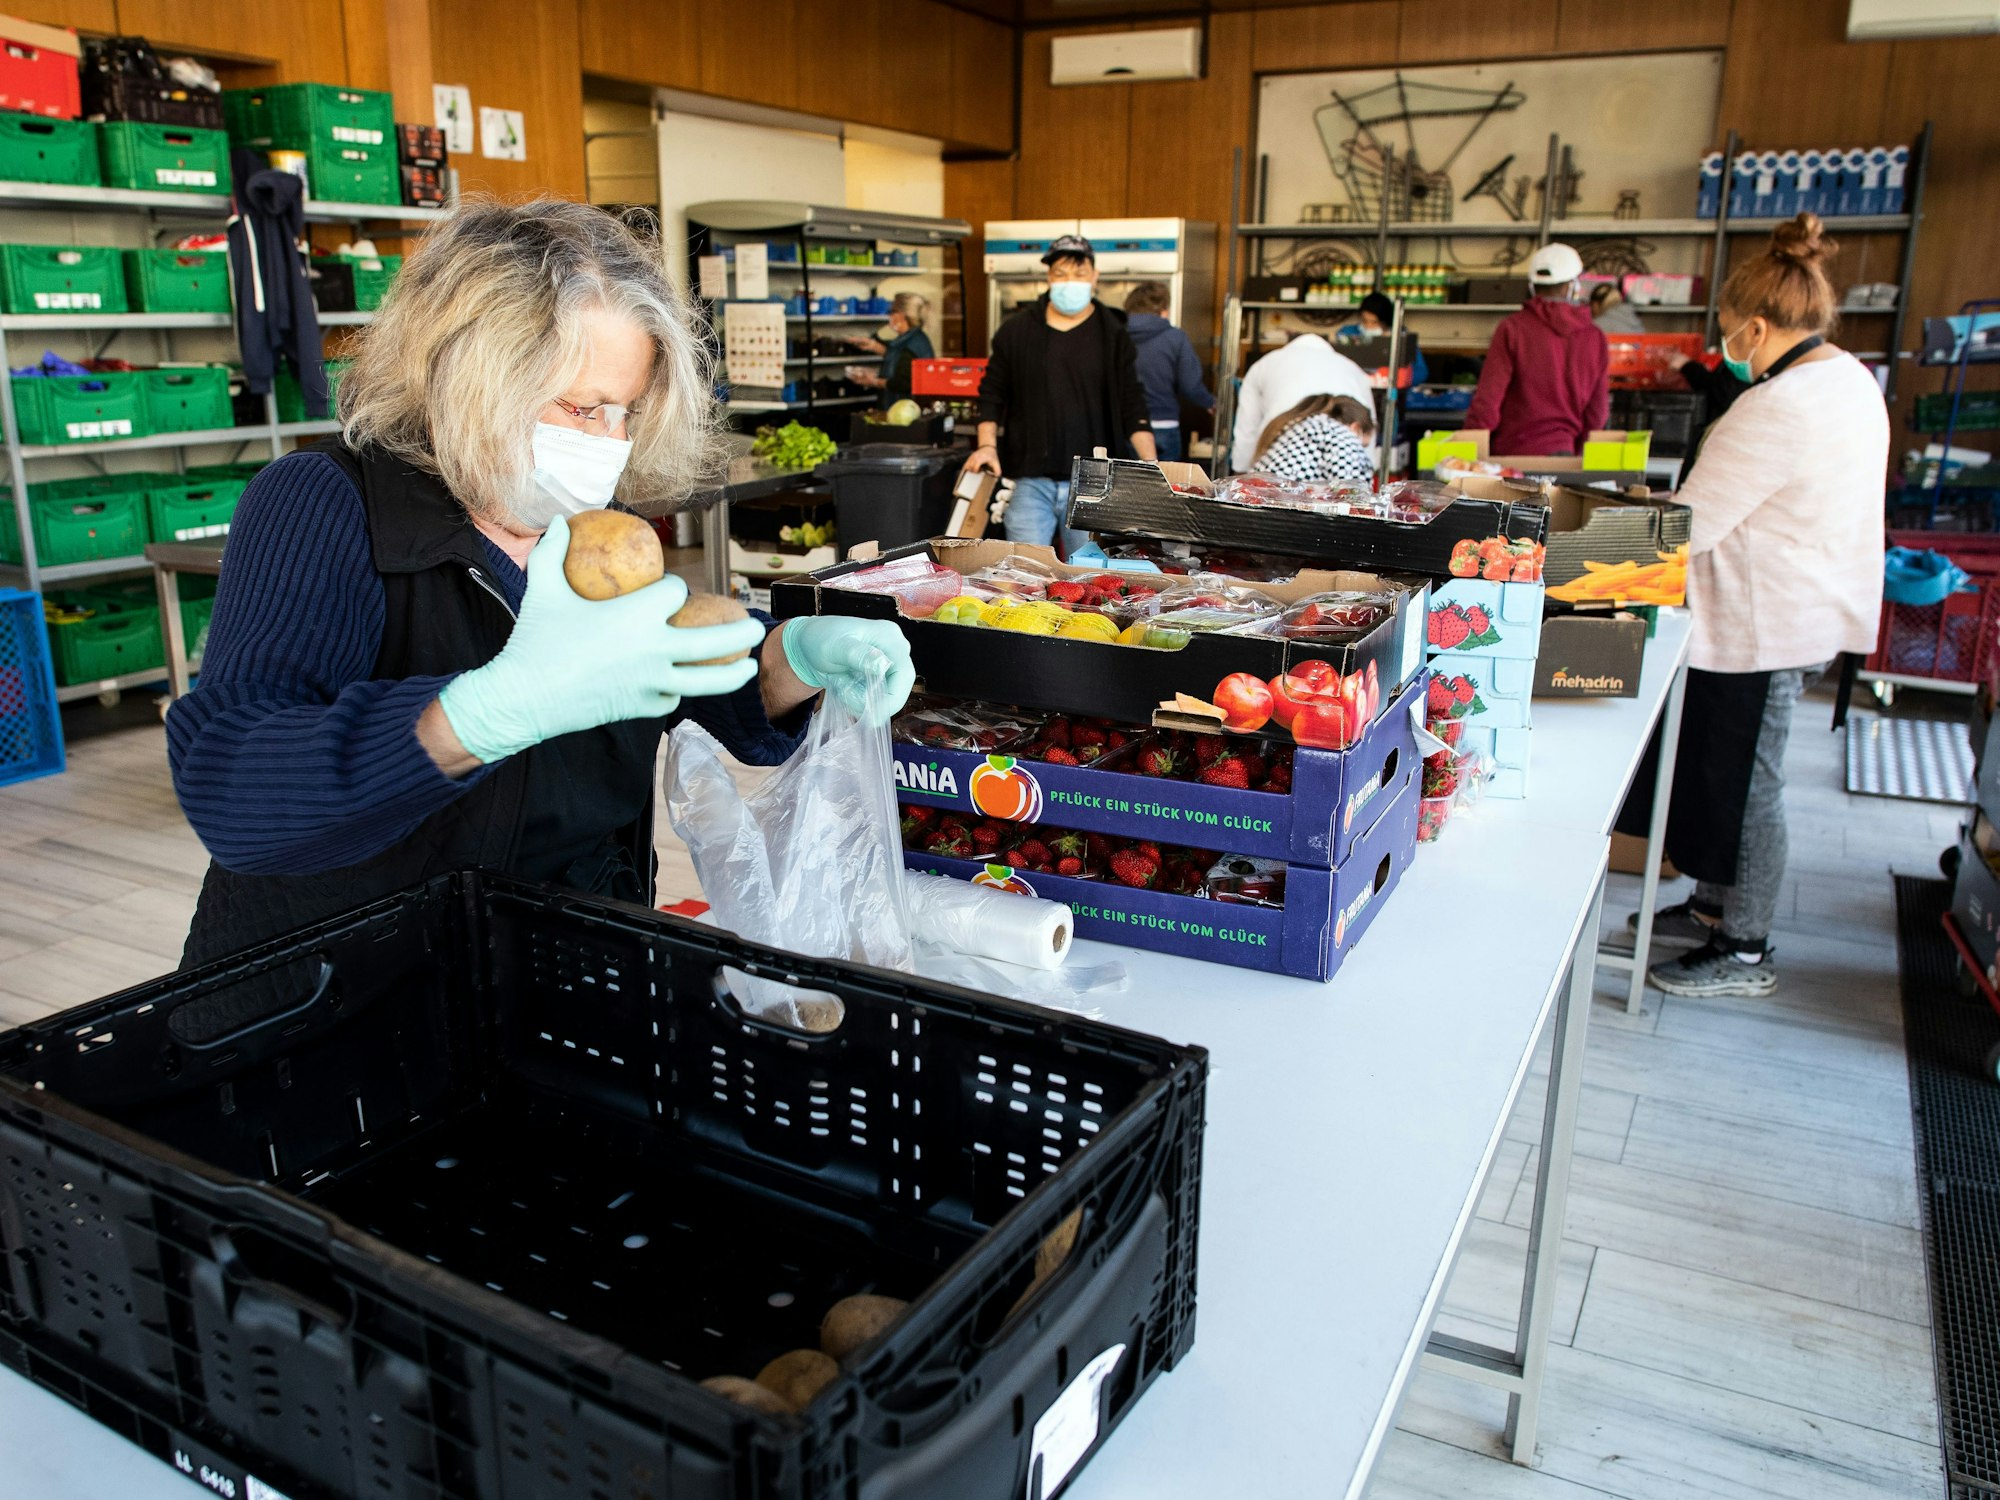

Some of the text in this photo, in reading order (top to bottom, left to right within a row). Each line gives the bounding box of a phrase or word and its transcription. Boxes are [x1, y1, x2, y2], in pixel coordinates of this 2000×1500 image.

[1551, 675, 1623, 689] mehadrin
[893, 761, 958, 794] ANiA
[1050, 790, 1272, 833] PFLÜCK EIN STÜCK VOM GLÜCK
[1103, 909, 1126, 923] EIN
[1130, 914, 1176, 931] STÜCK
[1180, 922, 1214, 938] VOM
[1219, 928, 1267, 946] GLÜCK
